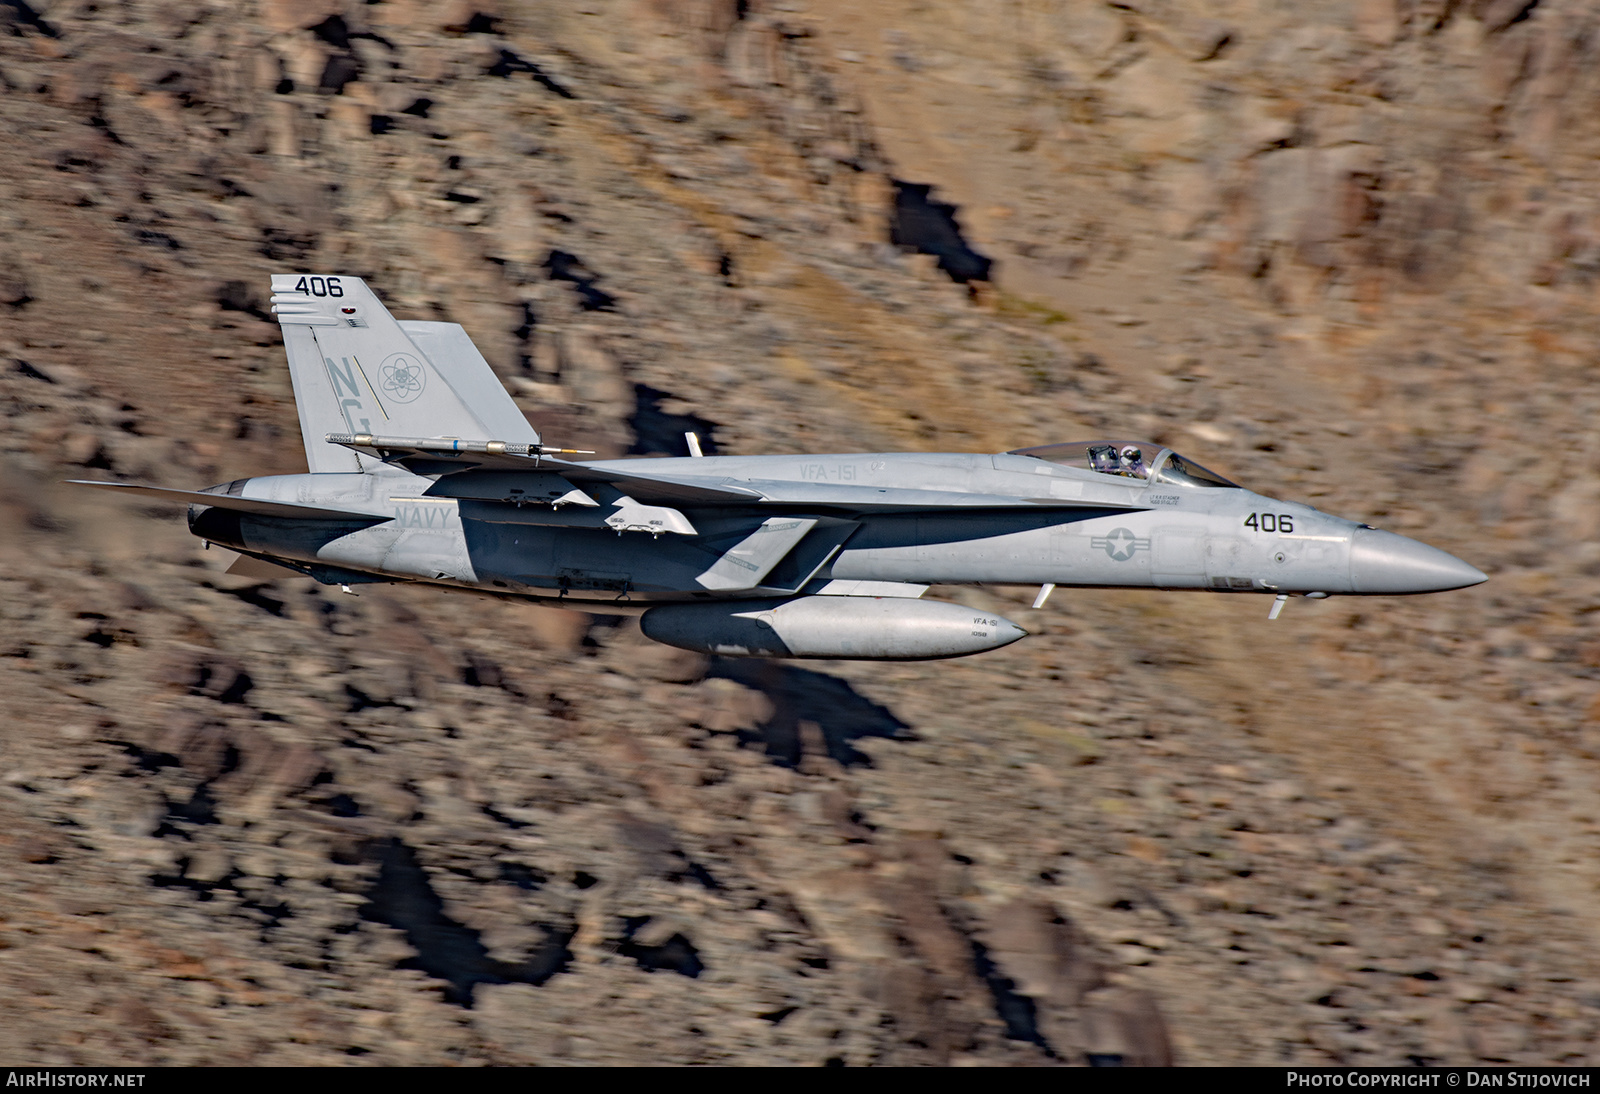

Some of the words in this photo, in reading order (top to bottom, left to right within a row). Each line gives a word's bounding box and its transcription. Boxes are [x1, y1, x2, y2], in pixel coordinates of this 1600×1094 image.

[294, 276, 344, 298] 406
[800, 464, 857, 481] VFA-151
[395, 506, 452, 529] NAVY
[1243, 512, 1294, 533] 406
[768, 523, 792, 532] DANGER
[726, 555, 750, 569] DANGER
[973, 617, 997, 626] VFA-151
